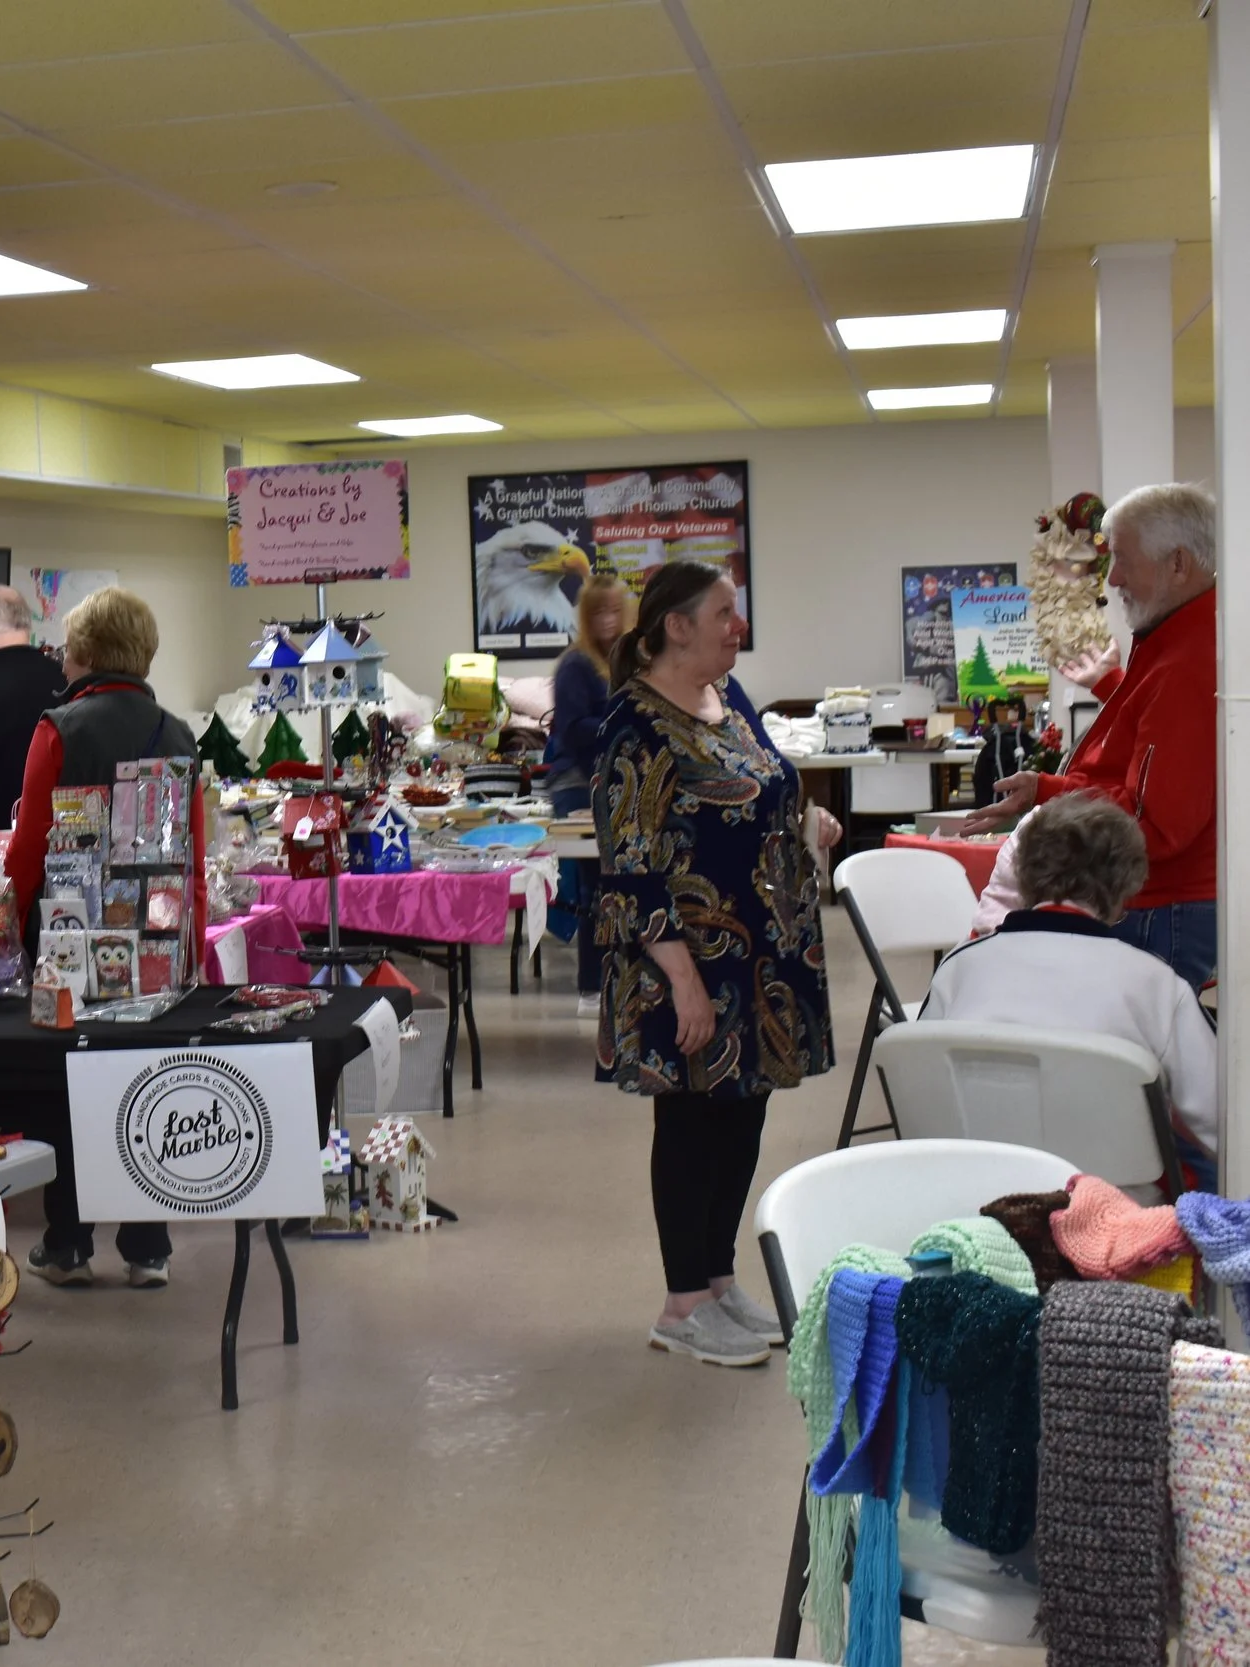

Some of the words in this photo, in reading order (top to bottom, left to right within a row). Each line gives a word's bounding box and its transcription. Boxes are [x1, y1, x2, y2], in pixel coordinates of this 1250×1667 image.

[259, 478, 337, 498] Creations
[343, 475, 362, 500] by
[484, 491, 493, 503] A
[496, 489, 543, 502] Grateful
[547, 486, 586, 500] Nation
[664, 480, 736, 494] Community
[257, 507, 312, 532] Jacqui
[317, 502, 336, 522] &
[339, 502, 367, 526] Joe
[485, 511, 494, 521] A
[497, 506, 544, 520] Grateful
[548, 504, 590, 519] Church
[639, 500, 686, 513] Thomas
[690, 497, 735, 509] Church
[596, 525, 644, 538] Saluting
[650, 523, 673, 535] Our
[676, 521, 729, 534] Veterans
[959, 590, 1026, 608] America
[984, 607, 1027, 625] Land
[135, 1080, 168, 1128] HANDMADE
[170, 1073, 201, 1084] CARDS
[204, 1076, 210, 1084] &
[212, 1079, 251, 1124] CREATIONS
[163, 1098, 222, 1139] Lost
[157, 1124, 240, 1164] Marble
[140, 1147, 252, 1194] LOSTMARBLECREATIONS.COM
